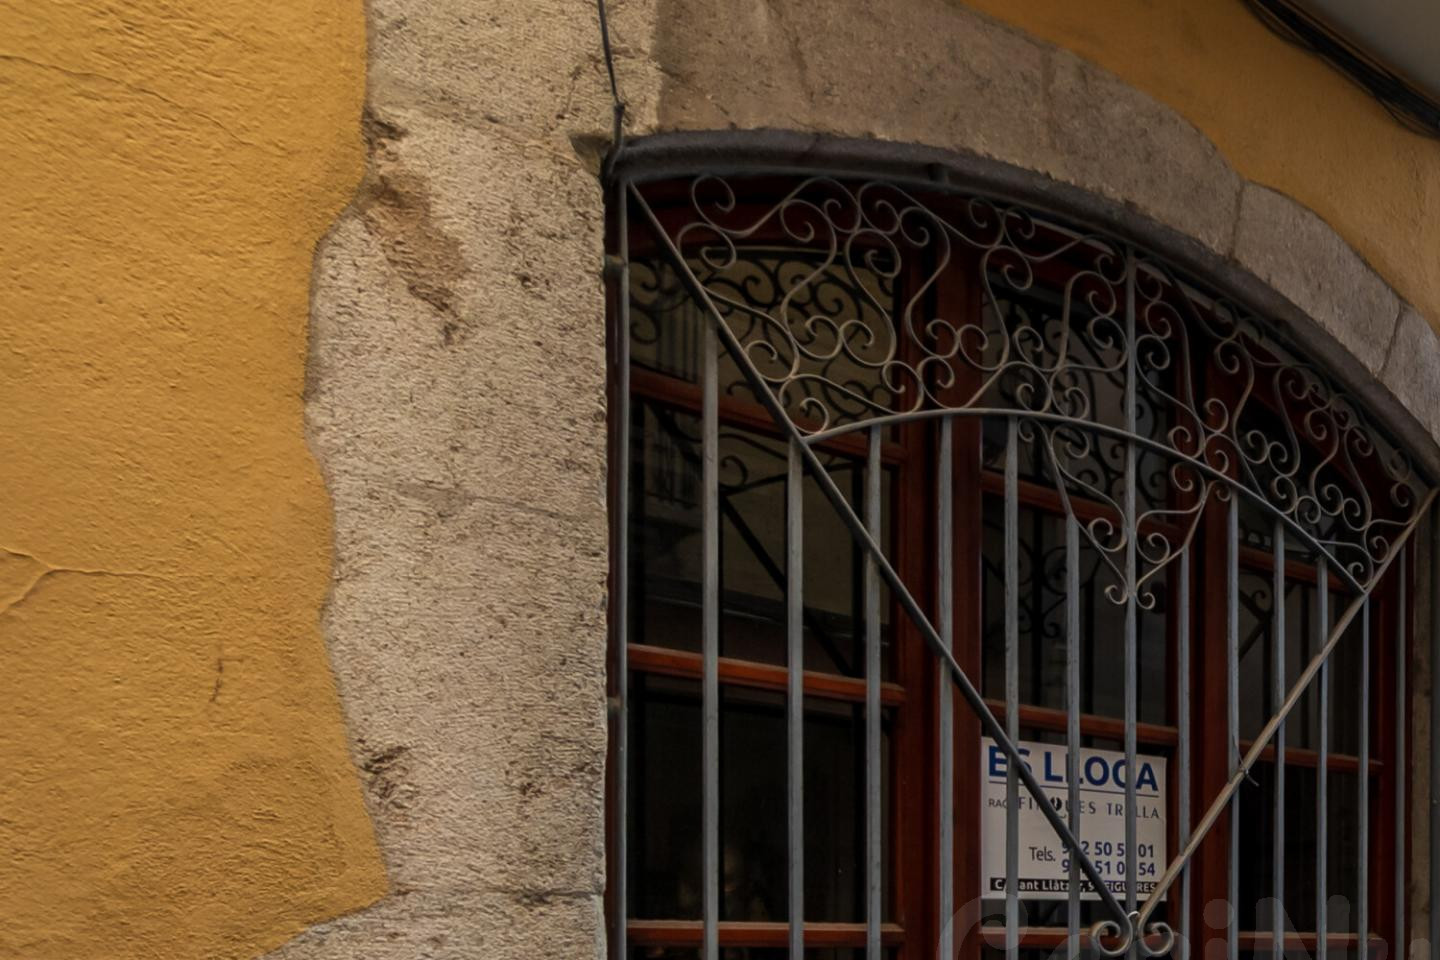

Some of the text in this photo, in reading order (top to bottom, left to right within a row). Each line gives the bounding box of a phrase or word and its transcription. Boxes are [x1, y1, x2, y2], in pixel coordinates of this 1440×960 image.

[1044, 751, 1158, 792] LOA
[1018, 797, 1096, 819] FIQES
[1106, 803, 1160, 819] TRLLA
[1029, 846, 1056, 862] Tels.
[1094, 842, 1112, 856] 50
[1138, 844, 1154, 858] 01
[1138, 863, 1155, 876] 54
[1104, 882, 1156, 892] FIGURES
